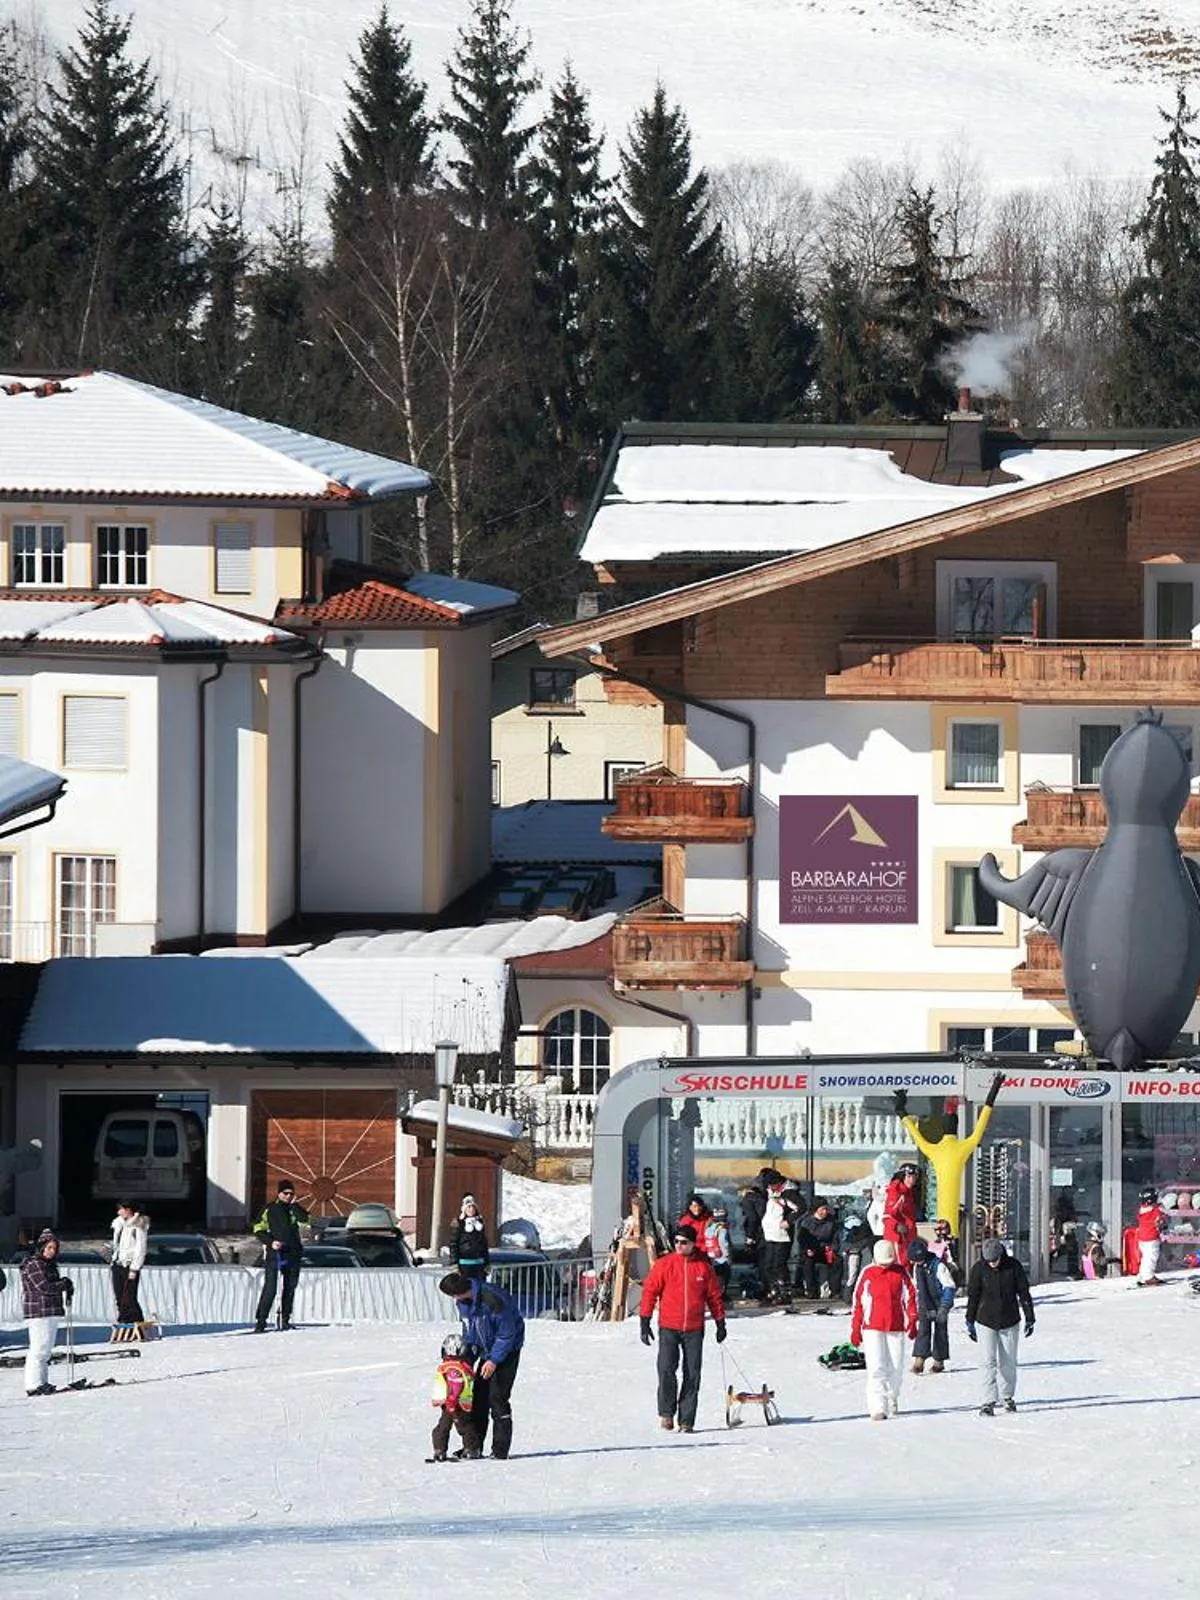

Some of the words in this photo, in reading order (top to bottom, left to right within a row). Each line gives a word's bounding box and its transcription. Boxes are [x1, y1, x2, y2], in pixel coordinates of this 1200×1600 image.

[791, 871, 907, 887] BARBARAHOF
[791, 894, 824, 903] ALPINE
[876, 894, 907, 903] HOTEL
[816, 905, 834, 913] AM
[865, 905, 907, 913] KAPRUN
[662, 1073, 808, 1094] SKISCHULE
[819, 1075, 958, 1087] SNOWBOARDSCHOOL
[1030, 1078, 1081, 1088] DOME
